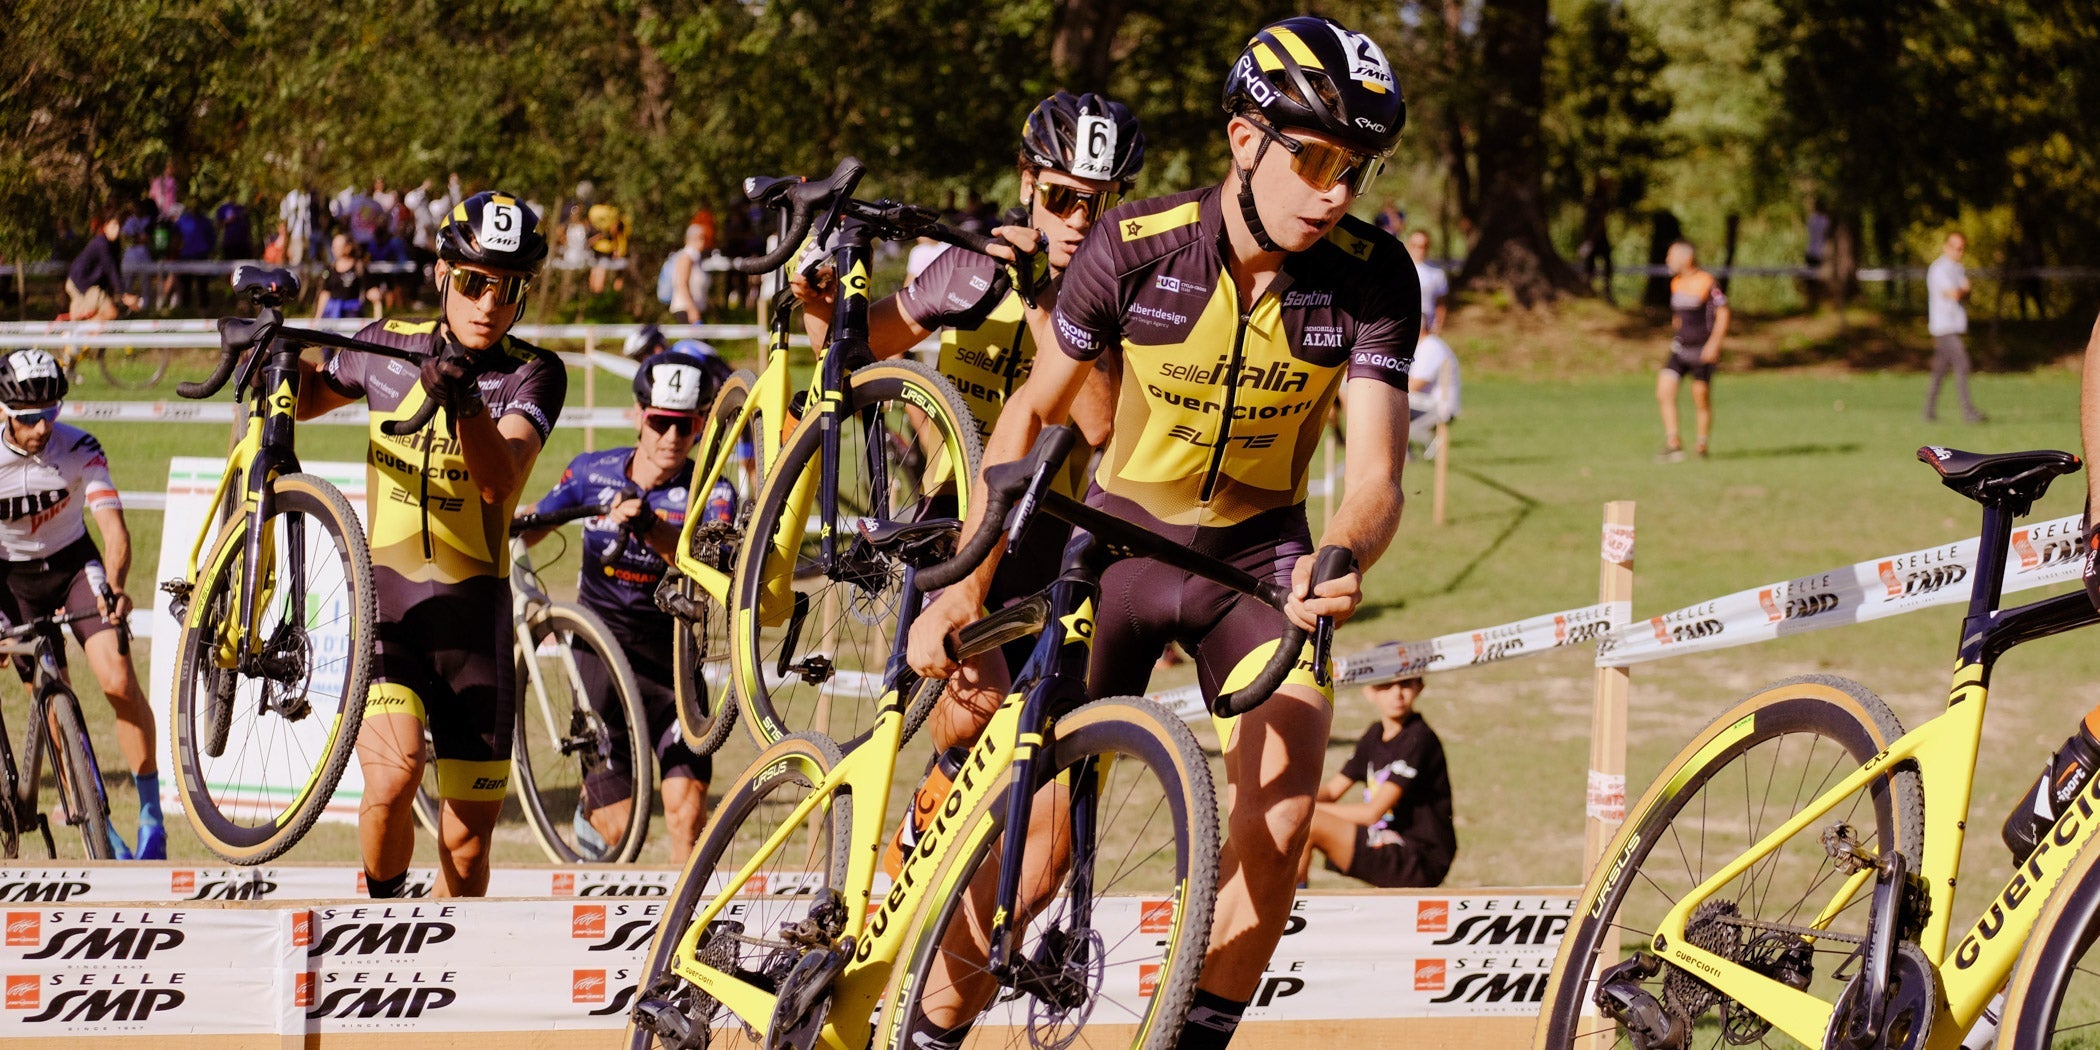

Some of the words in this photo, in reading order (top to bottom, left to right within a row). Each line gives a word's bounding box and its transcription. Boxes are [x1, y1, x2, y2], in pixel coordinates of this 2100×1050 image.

[1089, 121, 1108, 159] 6
[494, 206, 512, 232] 5
[850, 275, 866, 289] G
[1160, 278, 1178, 290] UCI
[1283, 290, 1333, 307] Santini
[1128, 303, 1188, 326] albertdesign
[1303, 333, 1343, 348] ALMI
[668, 369, 682, 394] 4
[276, 395, 291, 408] G
[901, 387, 937, 419] URSUS
[1896, 545, 1958, 571] SELLE
[1775, 574, 1830, 599] SELLE
[1566, 605, 1613, 623] SELLE
[1665, 602, 1716, 623] SELLE
[1073, 618, 1093, 639] G
[1864, 749, 1890, 772] CXS
[752, 760, 788, 792] URSUS
[580, 872, 668, 882] SELLE
[1591, 831, 1642, 920] URSUS
[50, 911, 186, 924] SELLE
[322, 906, 457, 920] SELLE
[22, 927, 186, 960] SMP
[307, 922, 457, 958] SMP
[1455, 957, 1549, 969] SELL
[1675, 949, 1722, 978] Guerciotti
[50, 972, 187, 986] SELLE
[323, 971, 457, 984] SELLE
[22, 988, 187, 1023] SMP
[306, 987, 457, 1020] SMP
